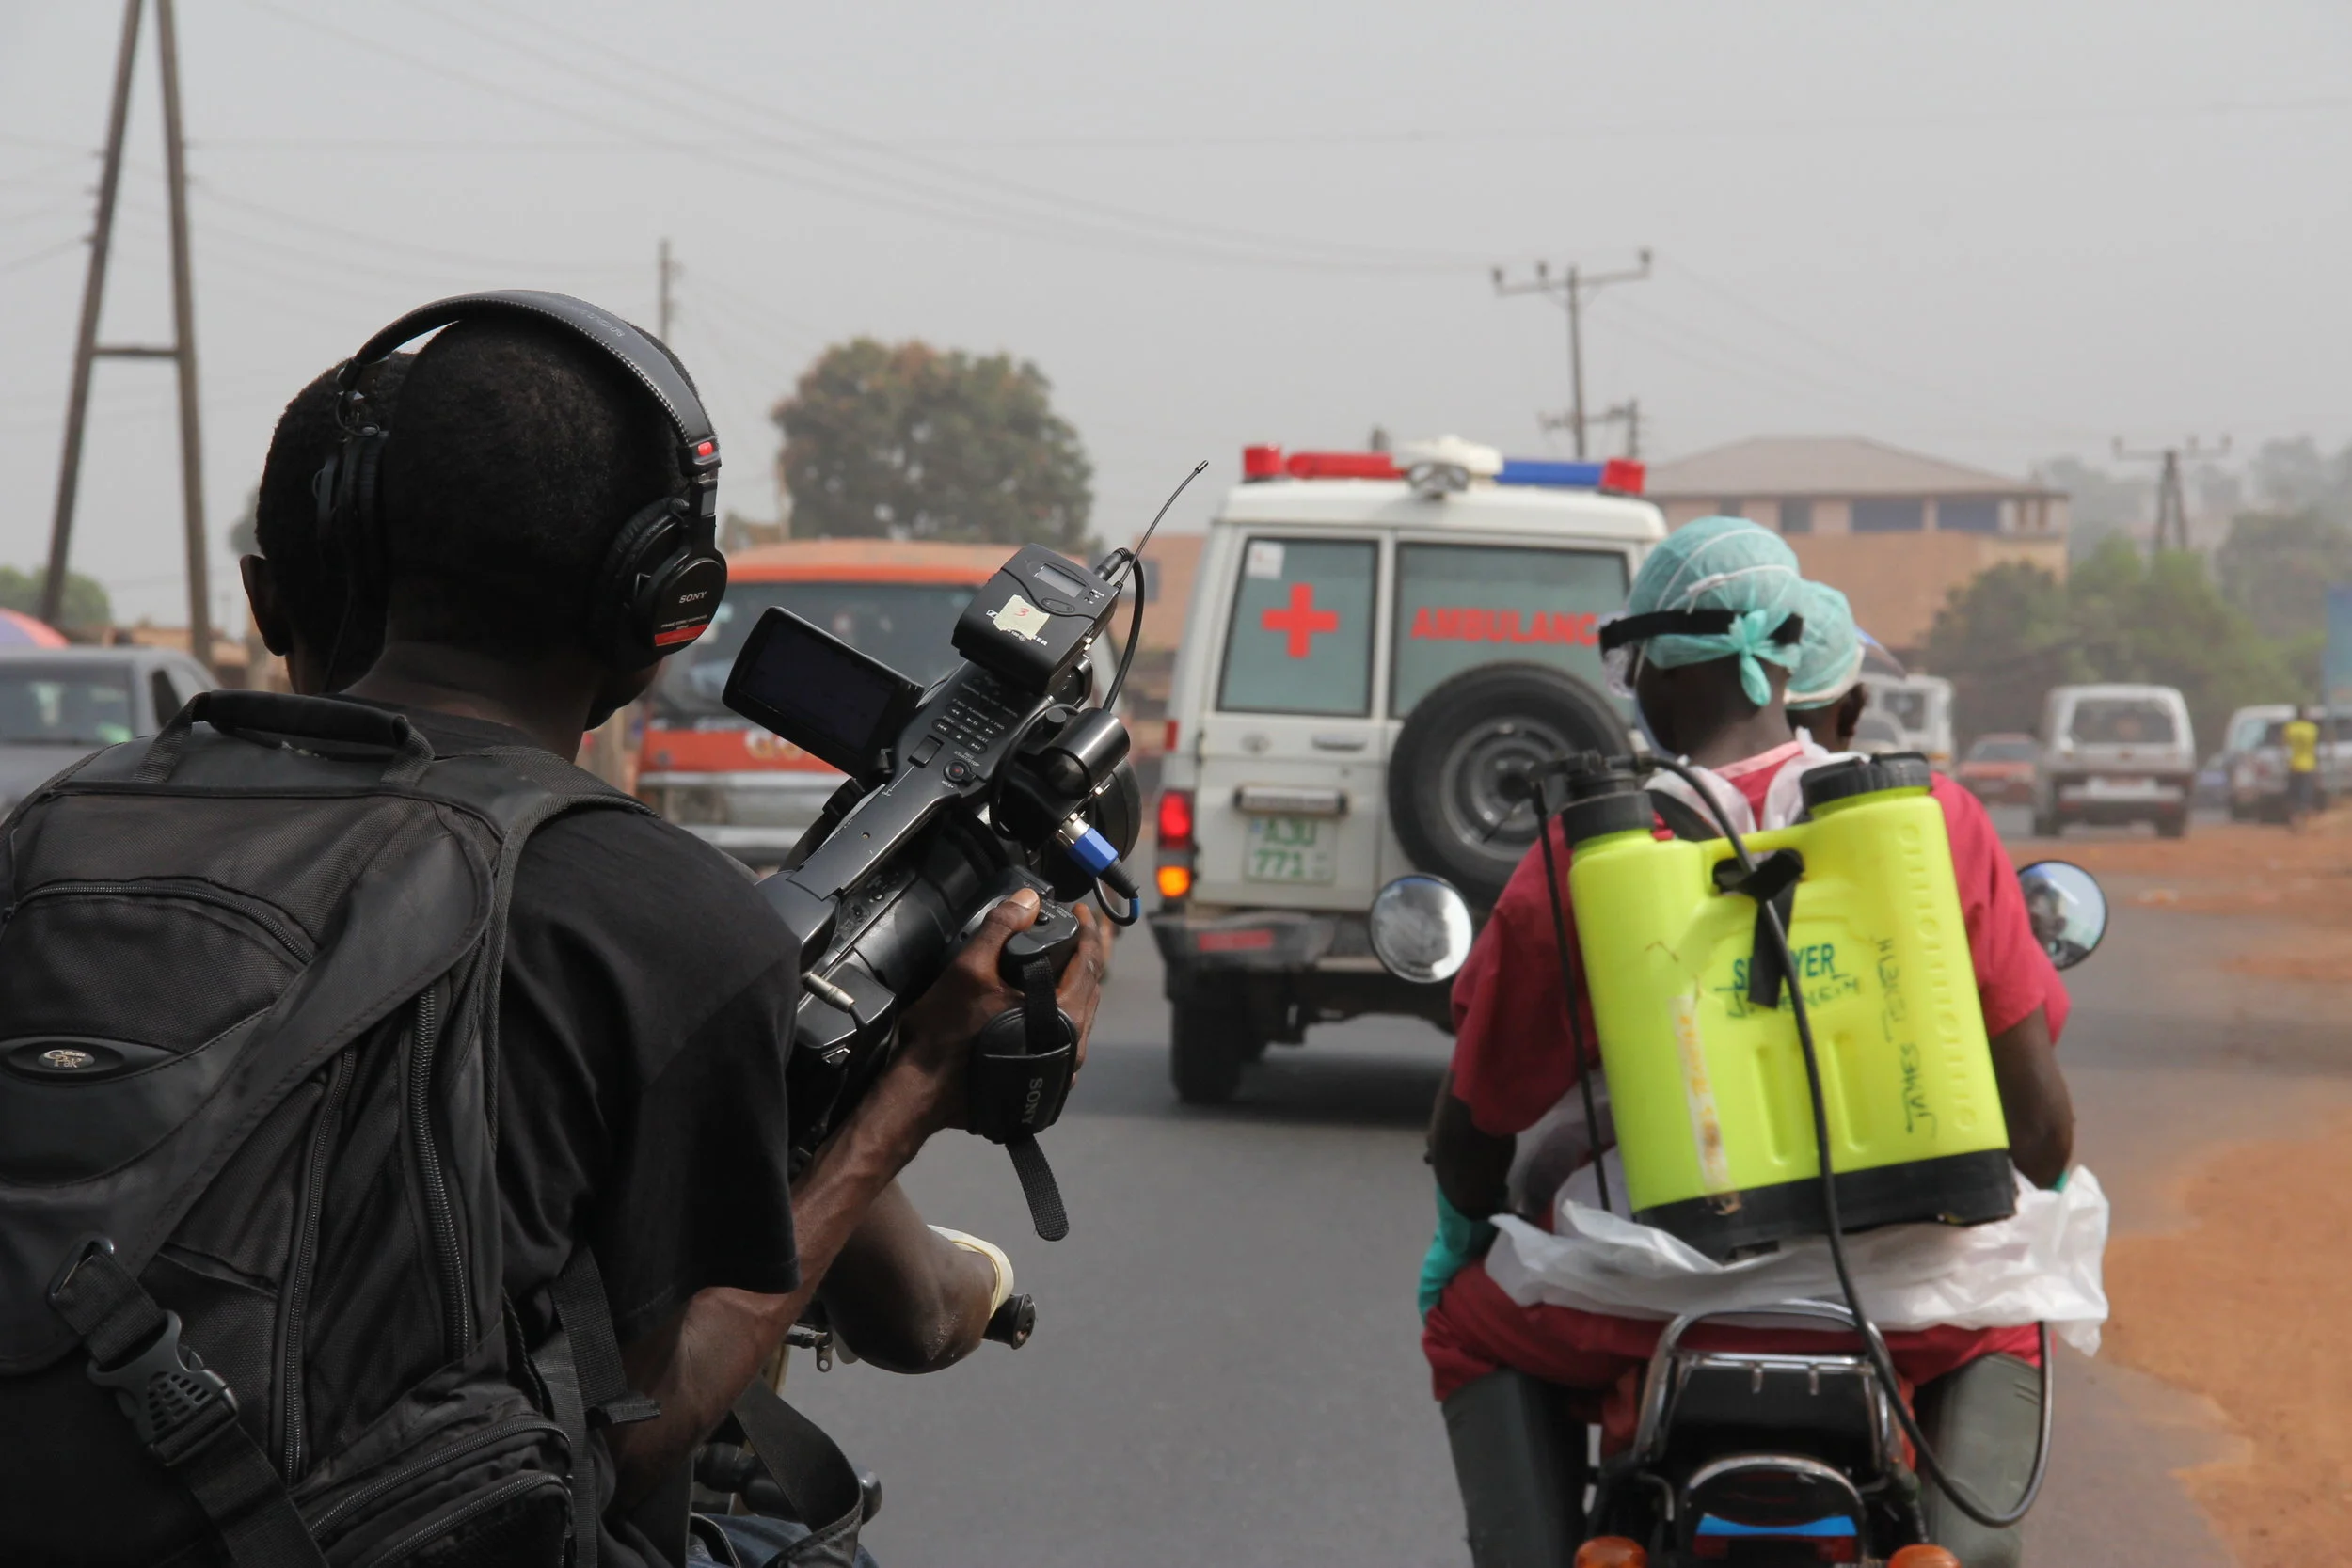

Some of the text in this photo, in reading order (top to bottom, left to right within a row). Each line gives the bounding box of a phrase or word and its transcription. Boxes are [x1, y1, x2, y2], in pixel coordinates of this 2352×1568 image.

[678, 591, 707, 604] SONY
[1015, 607, 1031, 617] 3
[1410, 607, 1599, 646] AMBULANC
[1021, 1077, 1043, 1124] SONY
